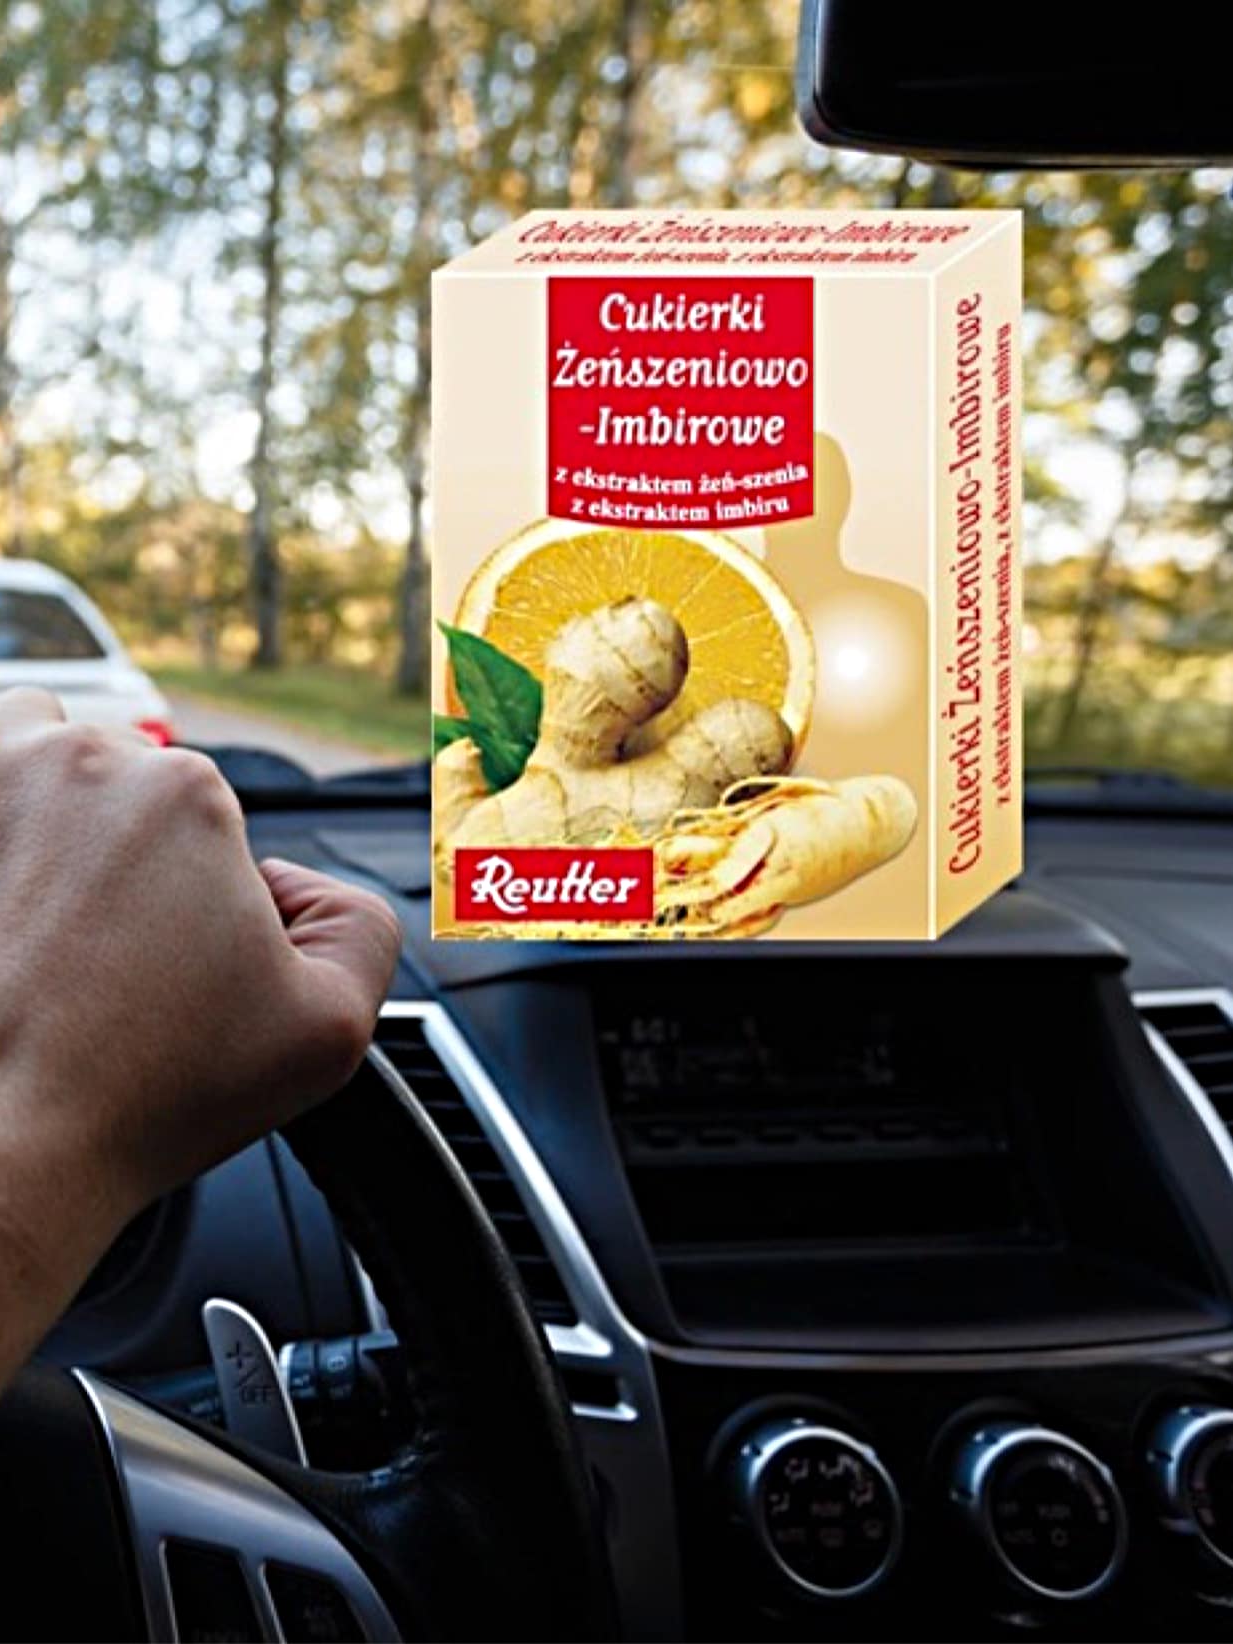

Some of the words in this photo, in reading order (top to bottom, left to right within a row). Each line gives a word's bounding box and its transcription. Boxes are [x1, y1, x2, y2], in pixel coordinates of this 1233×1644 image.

[598, 292, 765, 332] Cukierki
[553, 340, 809, 388] Żeńszeniowo
[578, 405, 785, 445] -Imbirowe
[554, 465, 569, 482] z
[571, 467, 693, 494] ekstraktem
[570, 496, 585, 514] z
[588, 497, 710, 521] ekstraktem
[715, 495, 790, 520] imbiru
[948, 717, 982, 874] Cukierki
[470, 854, 641, 914] Reutter
